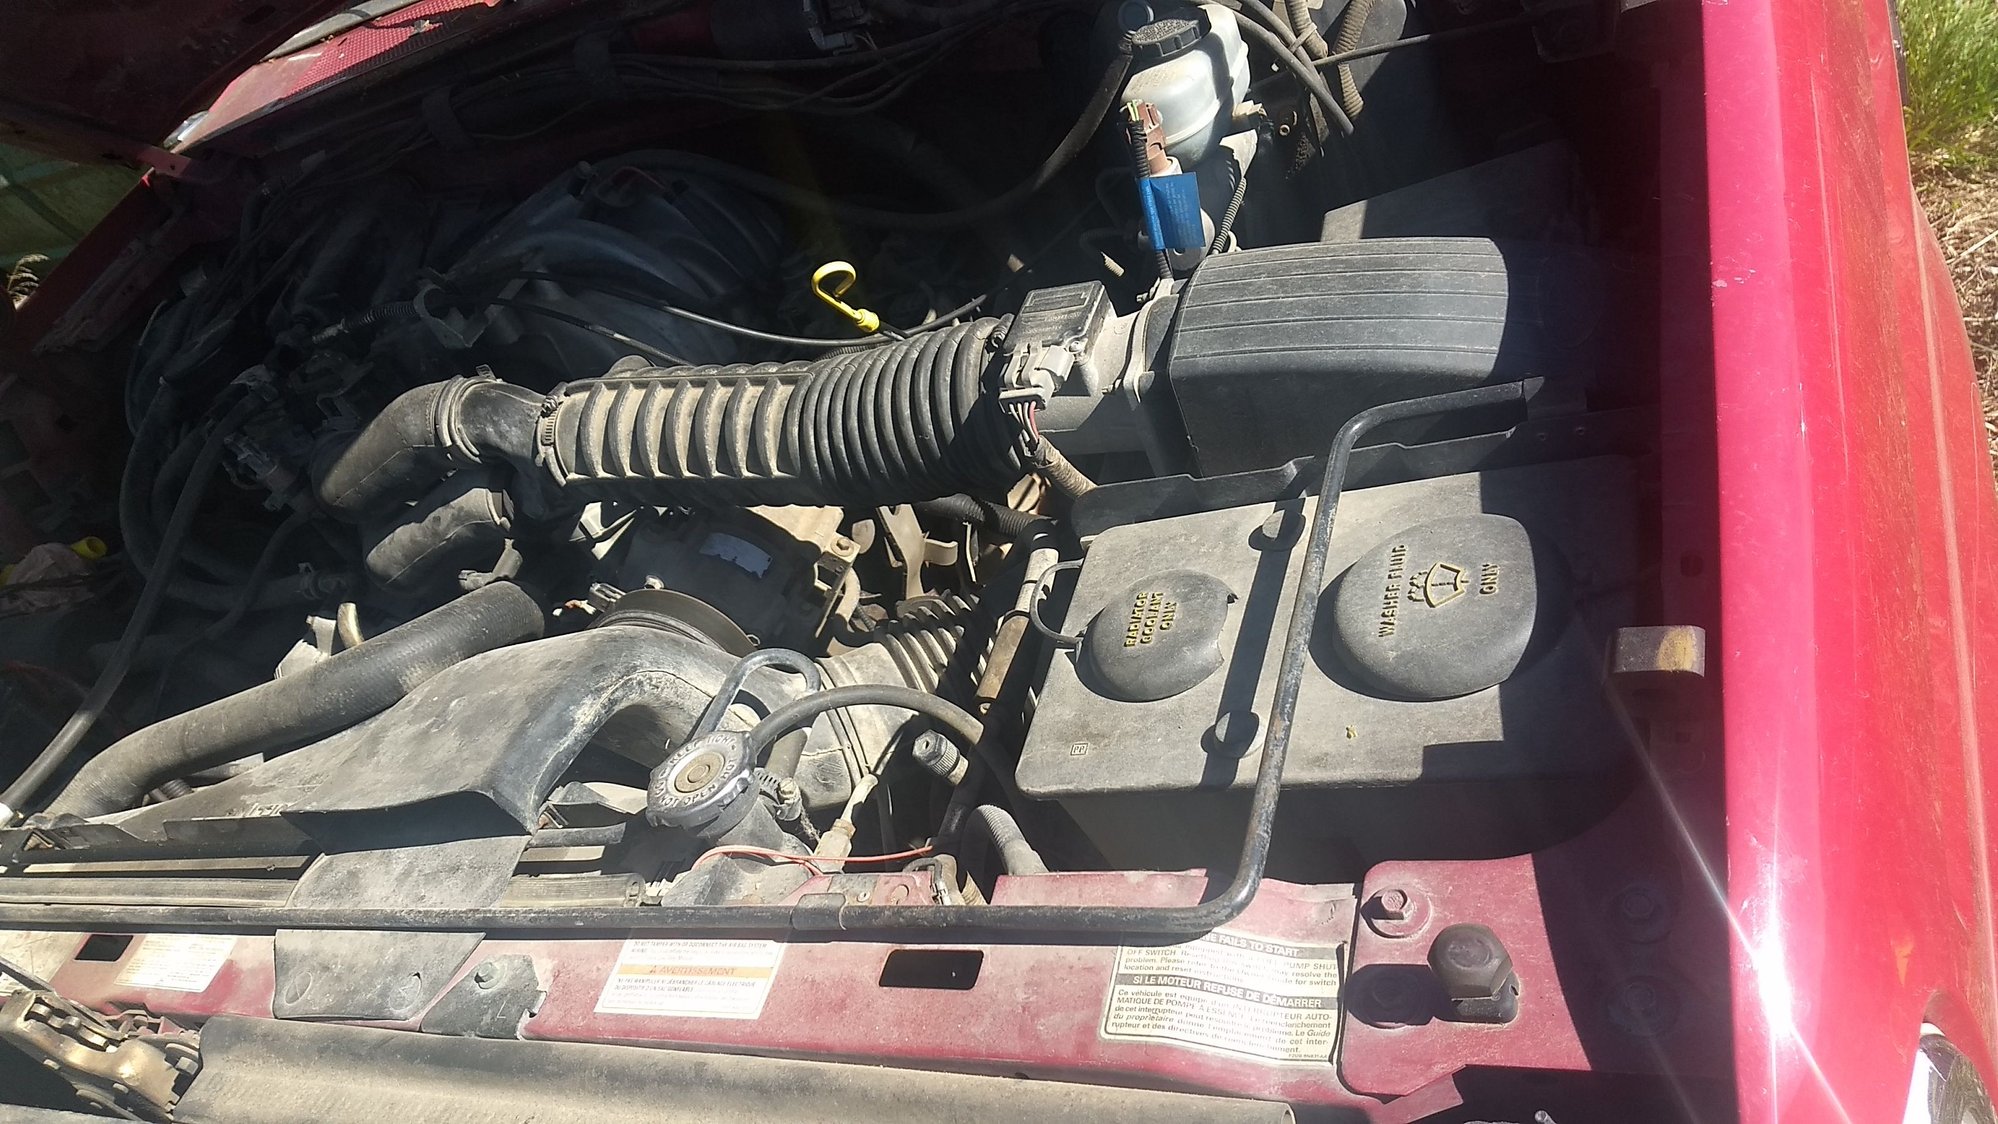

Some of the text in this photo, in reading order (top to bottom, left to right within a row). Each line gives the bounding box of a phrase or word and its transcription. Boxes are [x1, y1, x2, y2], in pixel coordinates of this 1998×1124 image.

[1378, 544, 1406, 638] WASHER FLUID
[1479, 563, 1500, 595] ONLY
[1123, 592, 1148, 648] RADIATOR
[1140, 592, 1164, 645] COOLANT
[1160, 602, 1177, 630] ONLY
[683, 784, 716, 806] OPEN
[721, 760, 738, 780] HOT
[1218, 933, 1247, 948] FAILS
[1248, 940, 1264, 951] TO
[1265, 943, 1299, 957] START
[1117, 997, 1151, 1005] MATIQUE
[1133, 976, 1142, 985] SI
[1145, 976, 1156, 985] LE
[1158, 976, 1201, 989] MOTEUR
[1203, 982, 1244, 997] REFUSE
[1245, 990, 1261, 1001] DE
[1111, 1021, 1140, 1029] rupteur
